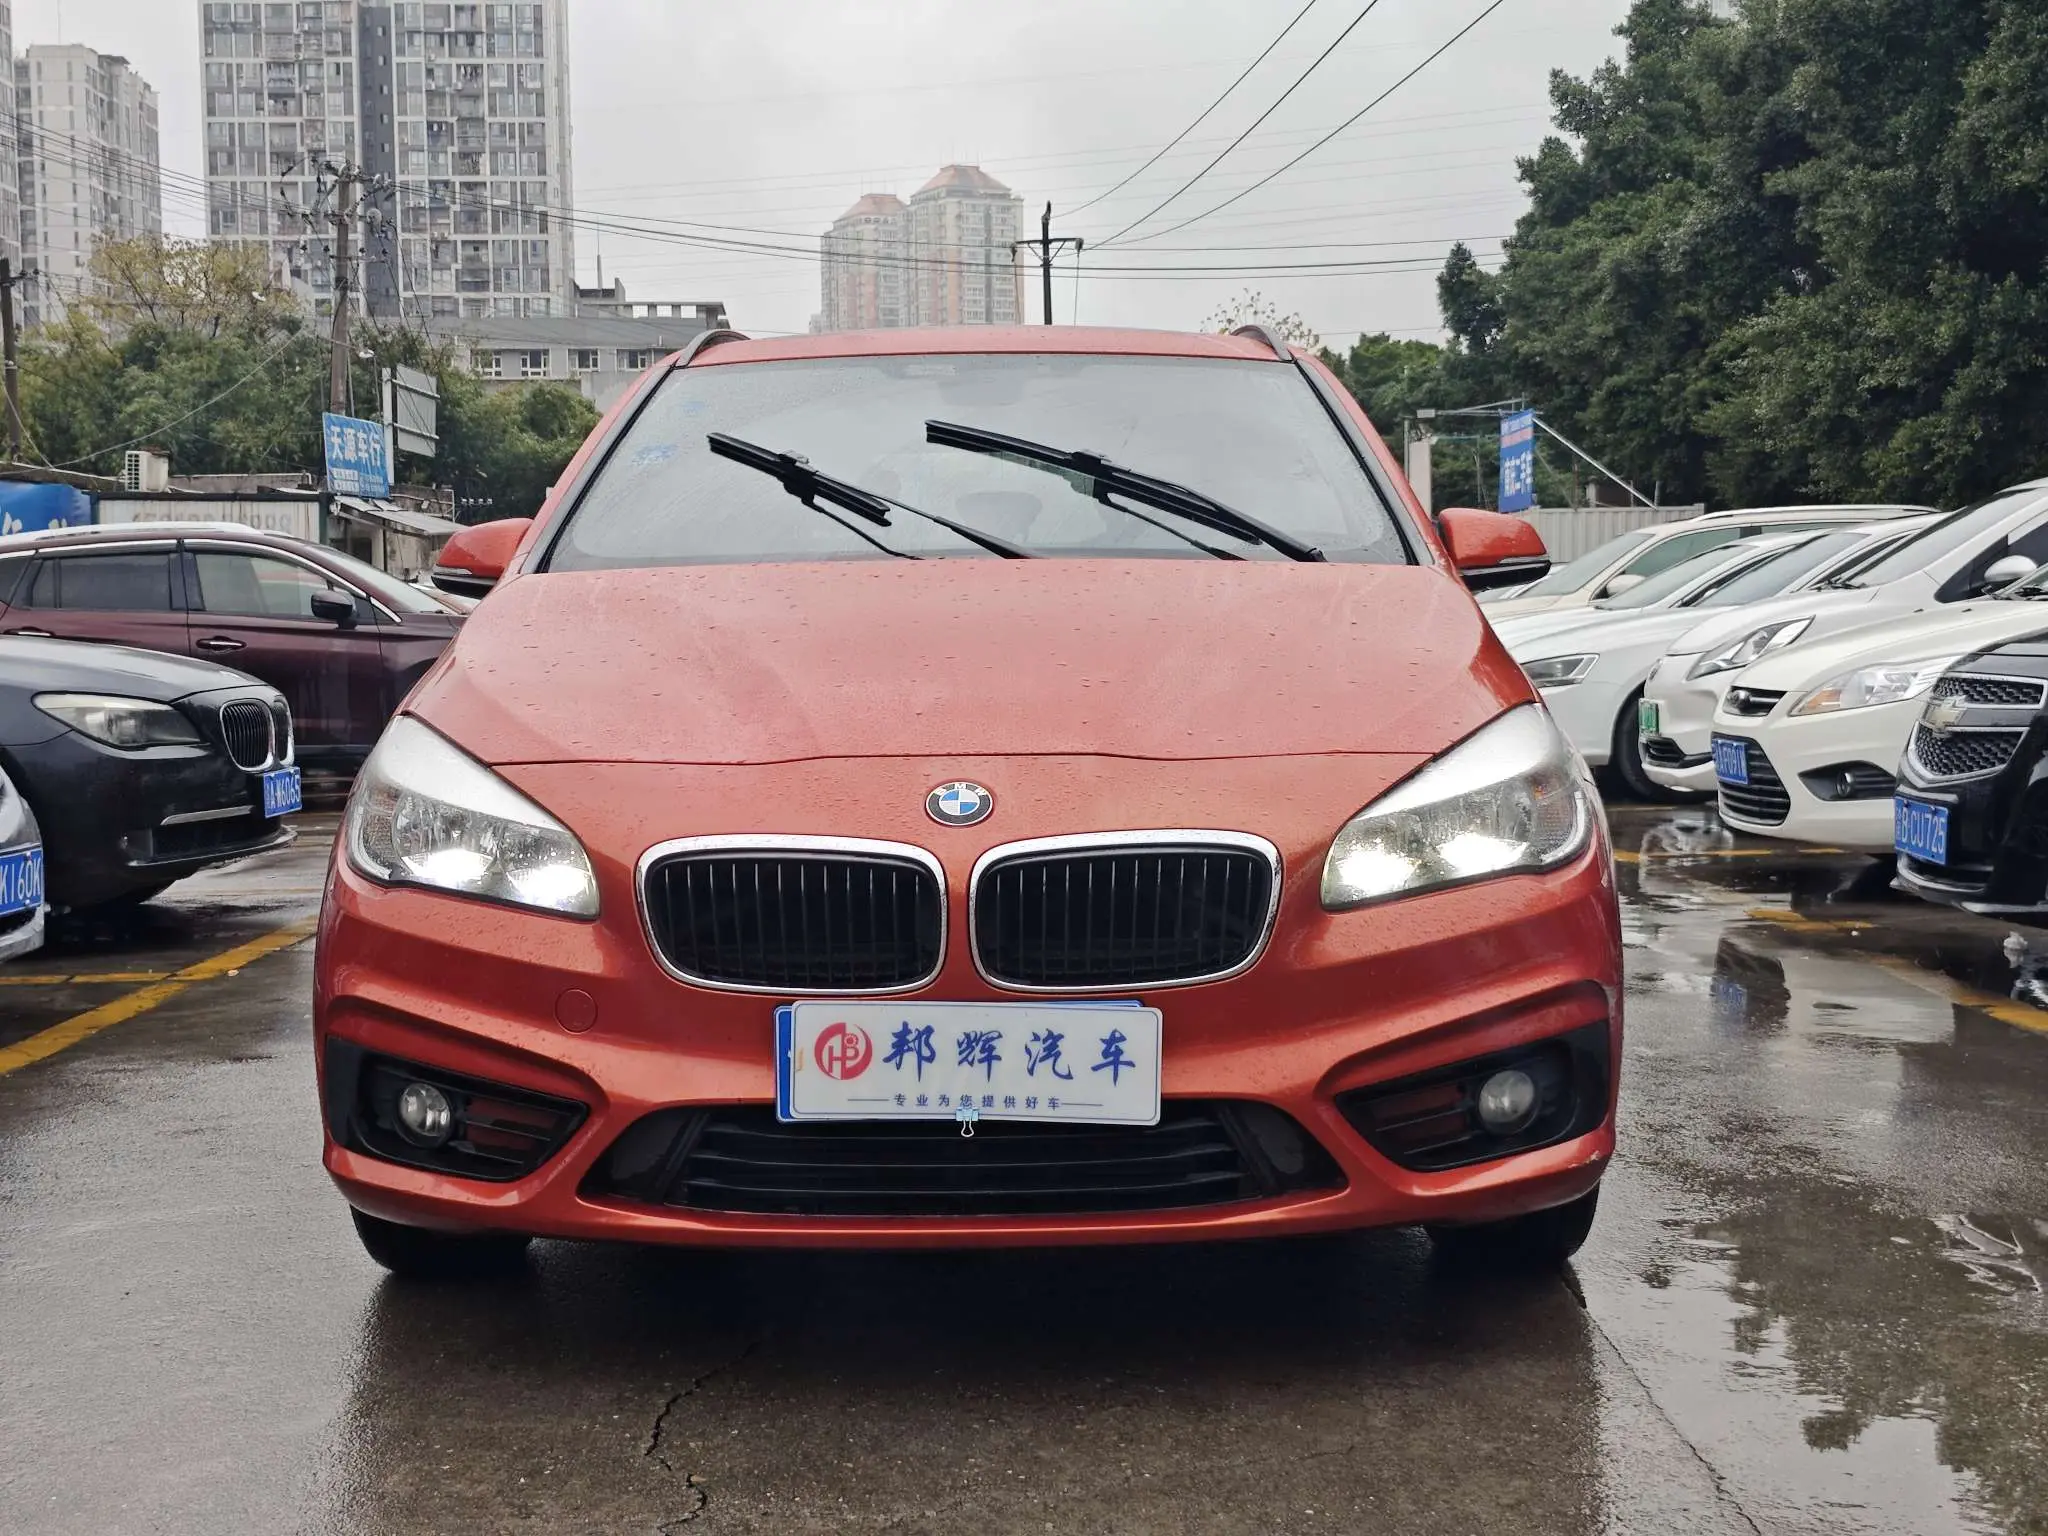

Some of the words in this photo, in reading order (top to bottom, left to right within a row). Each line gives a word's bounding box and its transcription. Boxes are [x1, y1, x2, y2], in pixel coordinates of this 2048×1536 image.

[931, 783, 988, 797] BMW
[882, 1020, 1136, 1087] 邦辉汽车
[894, 1093, 1061, 1110] 专业为您提供好车
